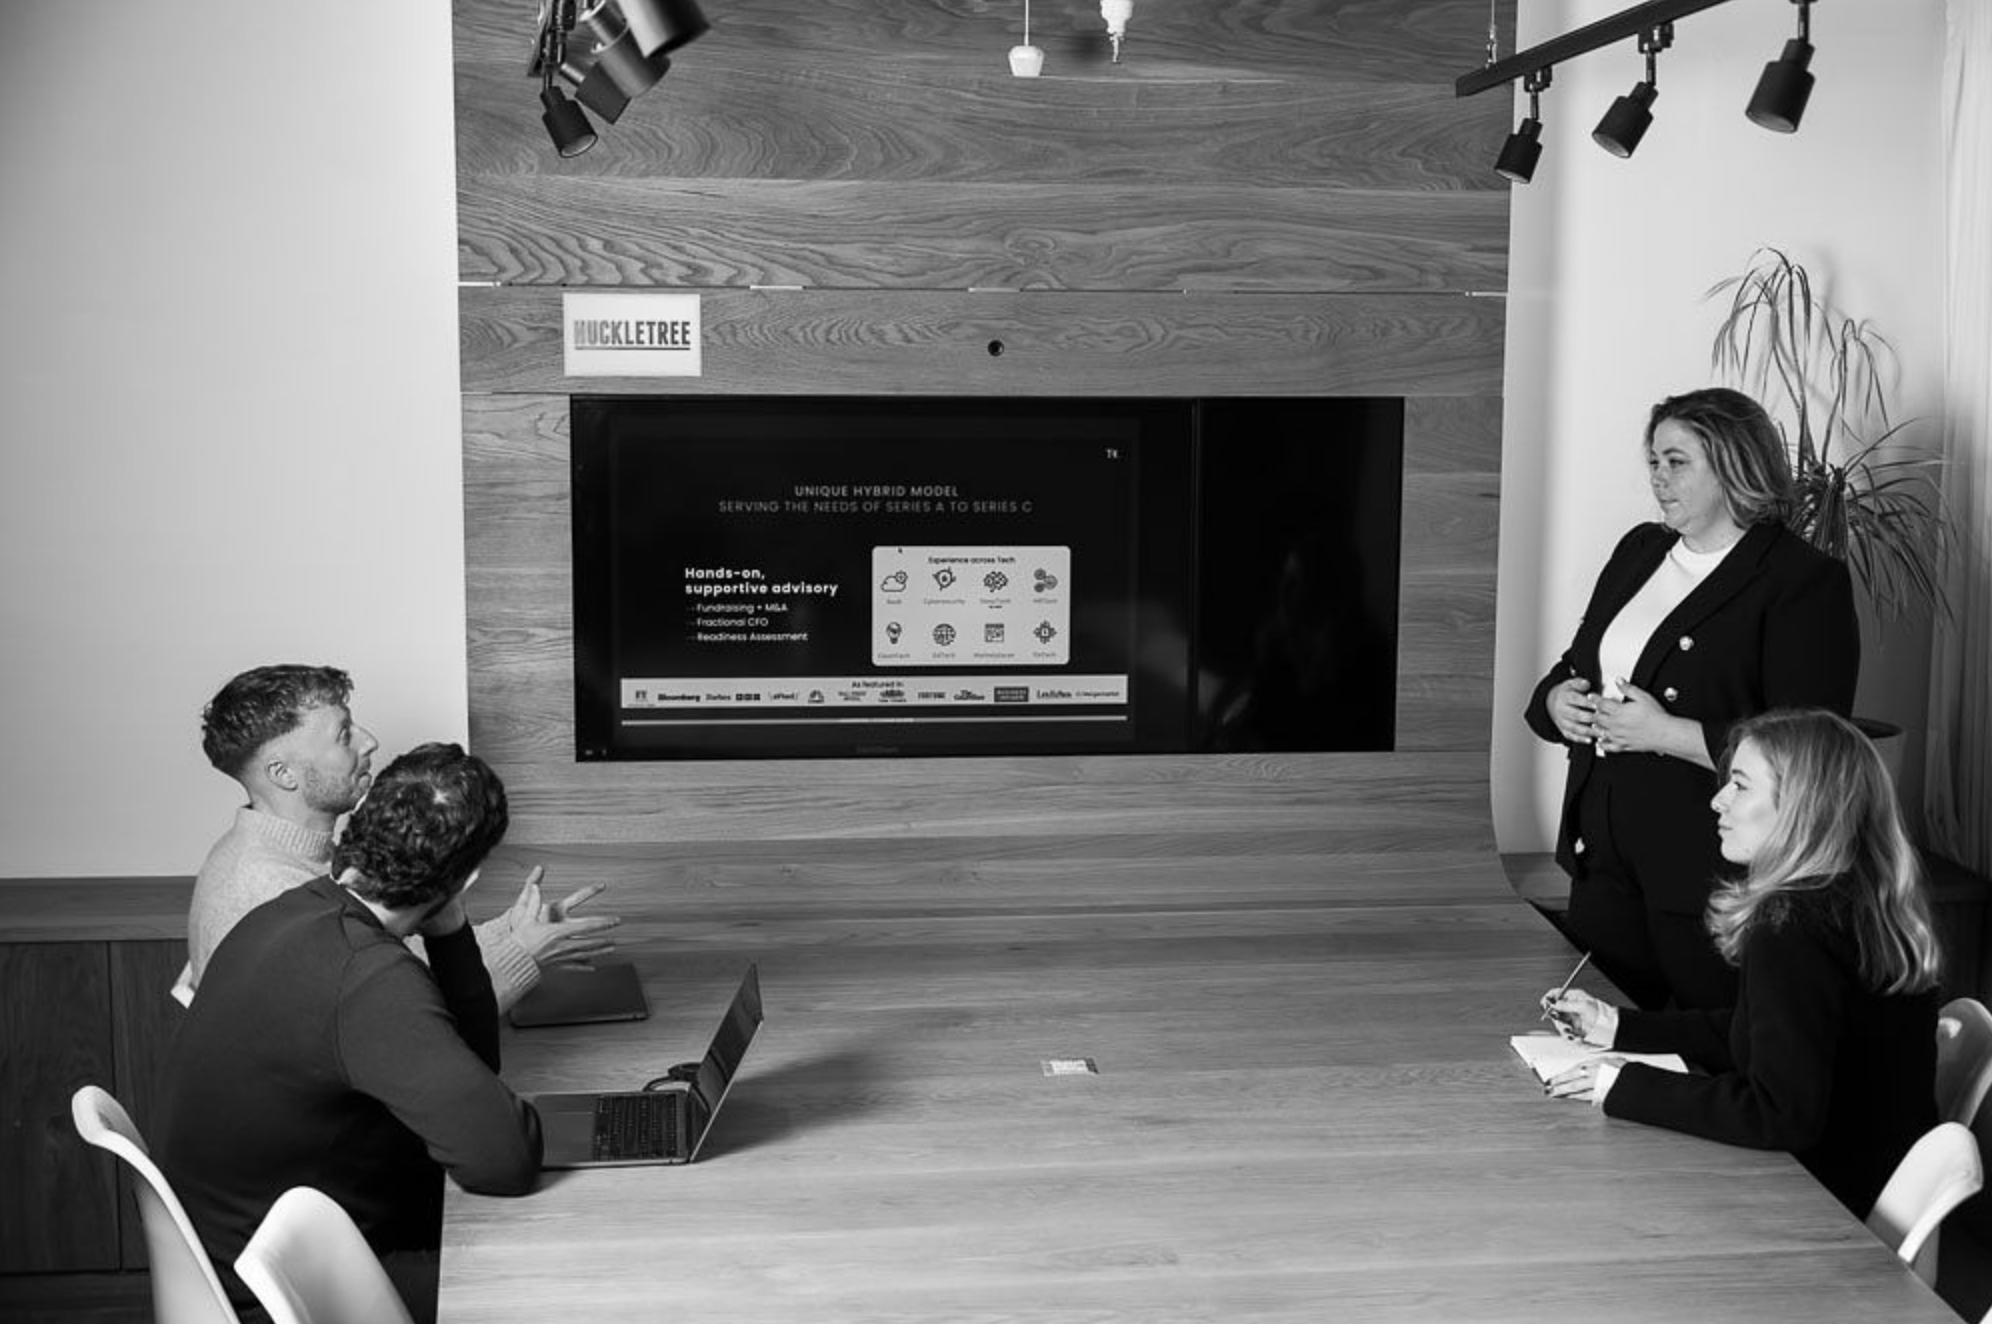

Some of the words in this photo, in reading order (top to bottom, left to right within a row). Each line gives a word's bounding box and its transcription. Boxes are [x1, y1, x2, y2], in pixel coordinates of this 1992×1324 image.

[574, 320, 691, 345] HUCKLETREE
[794, 485, 848, 498] UNIQUE
[853, 485, 906, 497] HYBRID
[910, 485, 959, 497] MODEL
[718, 501, 779, 513] SERVING
[784, 501, 808, 513] THE
[813, 501, 858, 513] NEEDS
[862, 501, 880, 512] OF
[885, 501, 931, 512] SERIES
[935, 501, 945, 512] A
[950, 501, 969, 512] TO
[973, 501, 1018, 512] SERIES
[1021, 501, 1033, 512] C
[928, 556, 969, 565] Experience
[997, 556, 1015, 564] Tech
[685, 567, 765, 581] Hands-on,
[685, 581, 768, 597] supportive
[771, 581, 838, 597] advisory
[696, 603, 755, 615] Fundraising
[764, 603, 788, 612] M&A
[696, 617, 746, 627] Fractional
[747, 617, 769, 627] CFO
[696, 631, 747, 641] Readiness
[749, 631, 809, 641] Assessment
